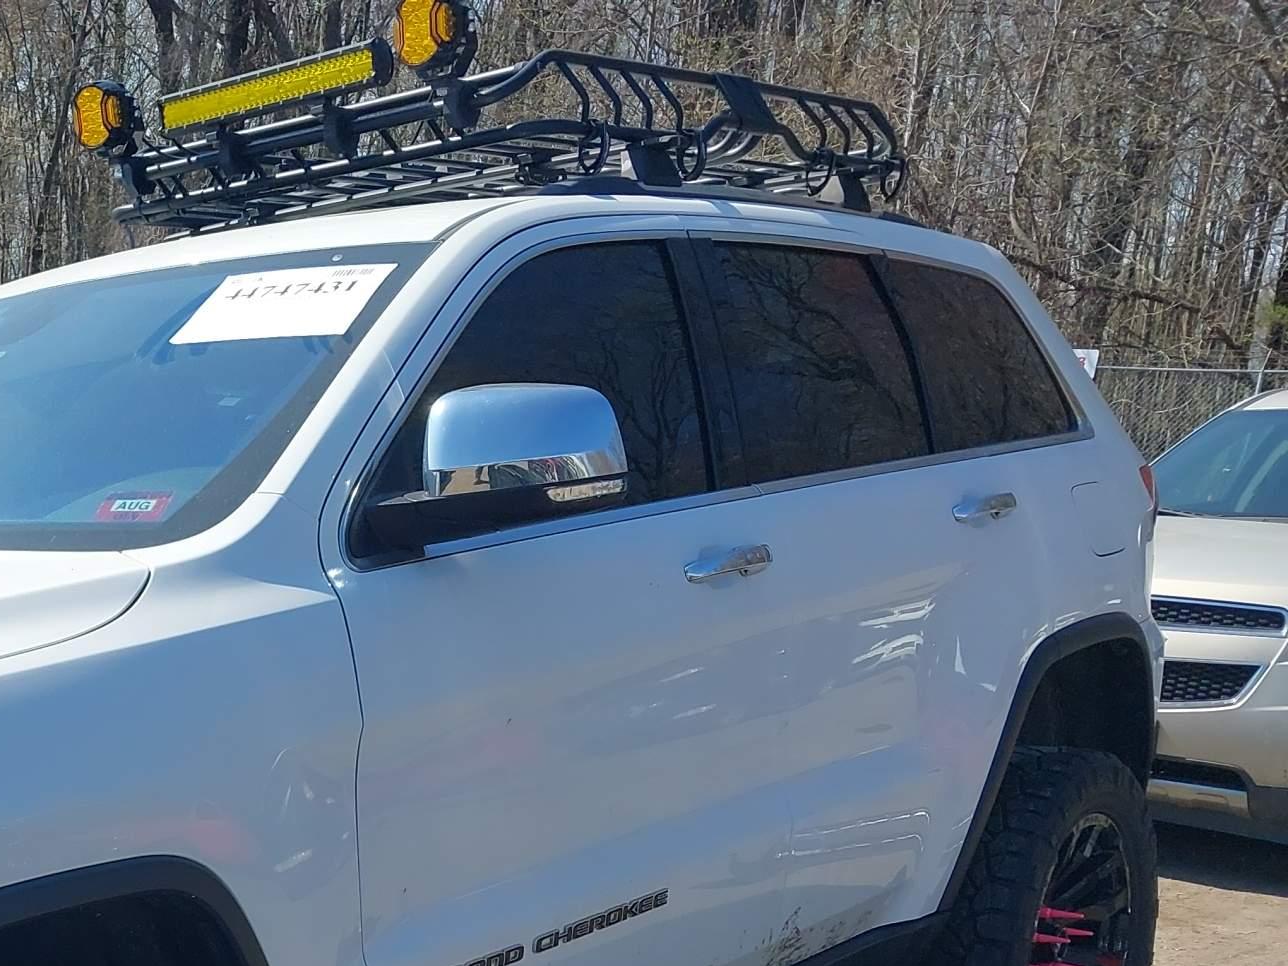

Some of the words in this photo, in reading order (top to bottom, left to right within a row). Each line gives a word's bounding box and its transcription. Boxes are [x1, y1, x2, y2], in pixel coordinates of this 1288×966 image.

[224, 279, 359, 300] 44747431
[115, 501, 152, 510] AUG
[532, 887, 669, 954] CHEROKEE
